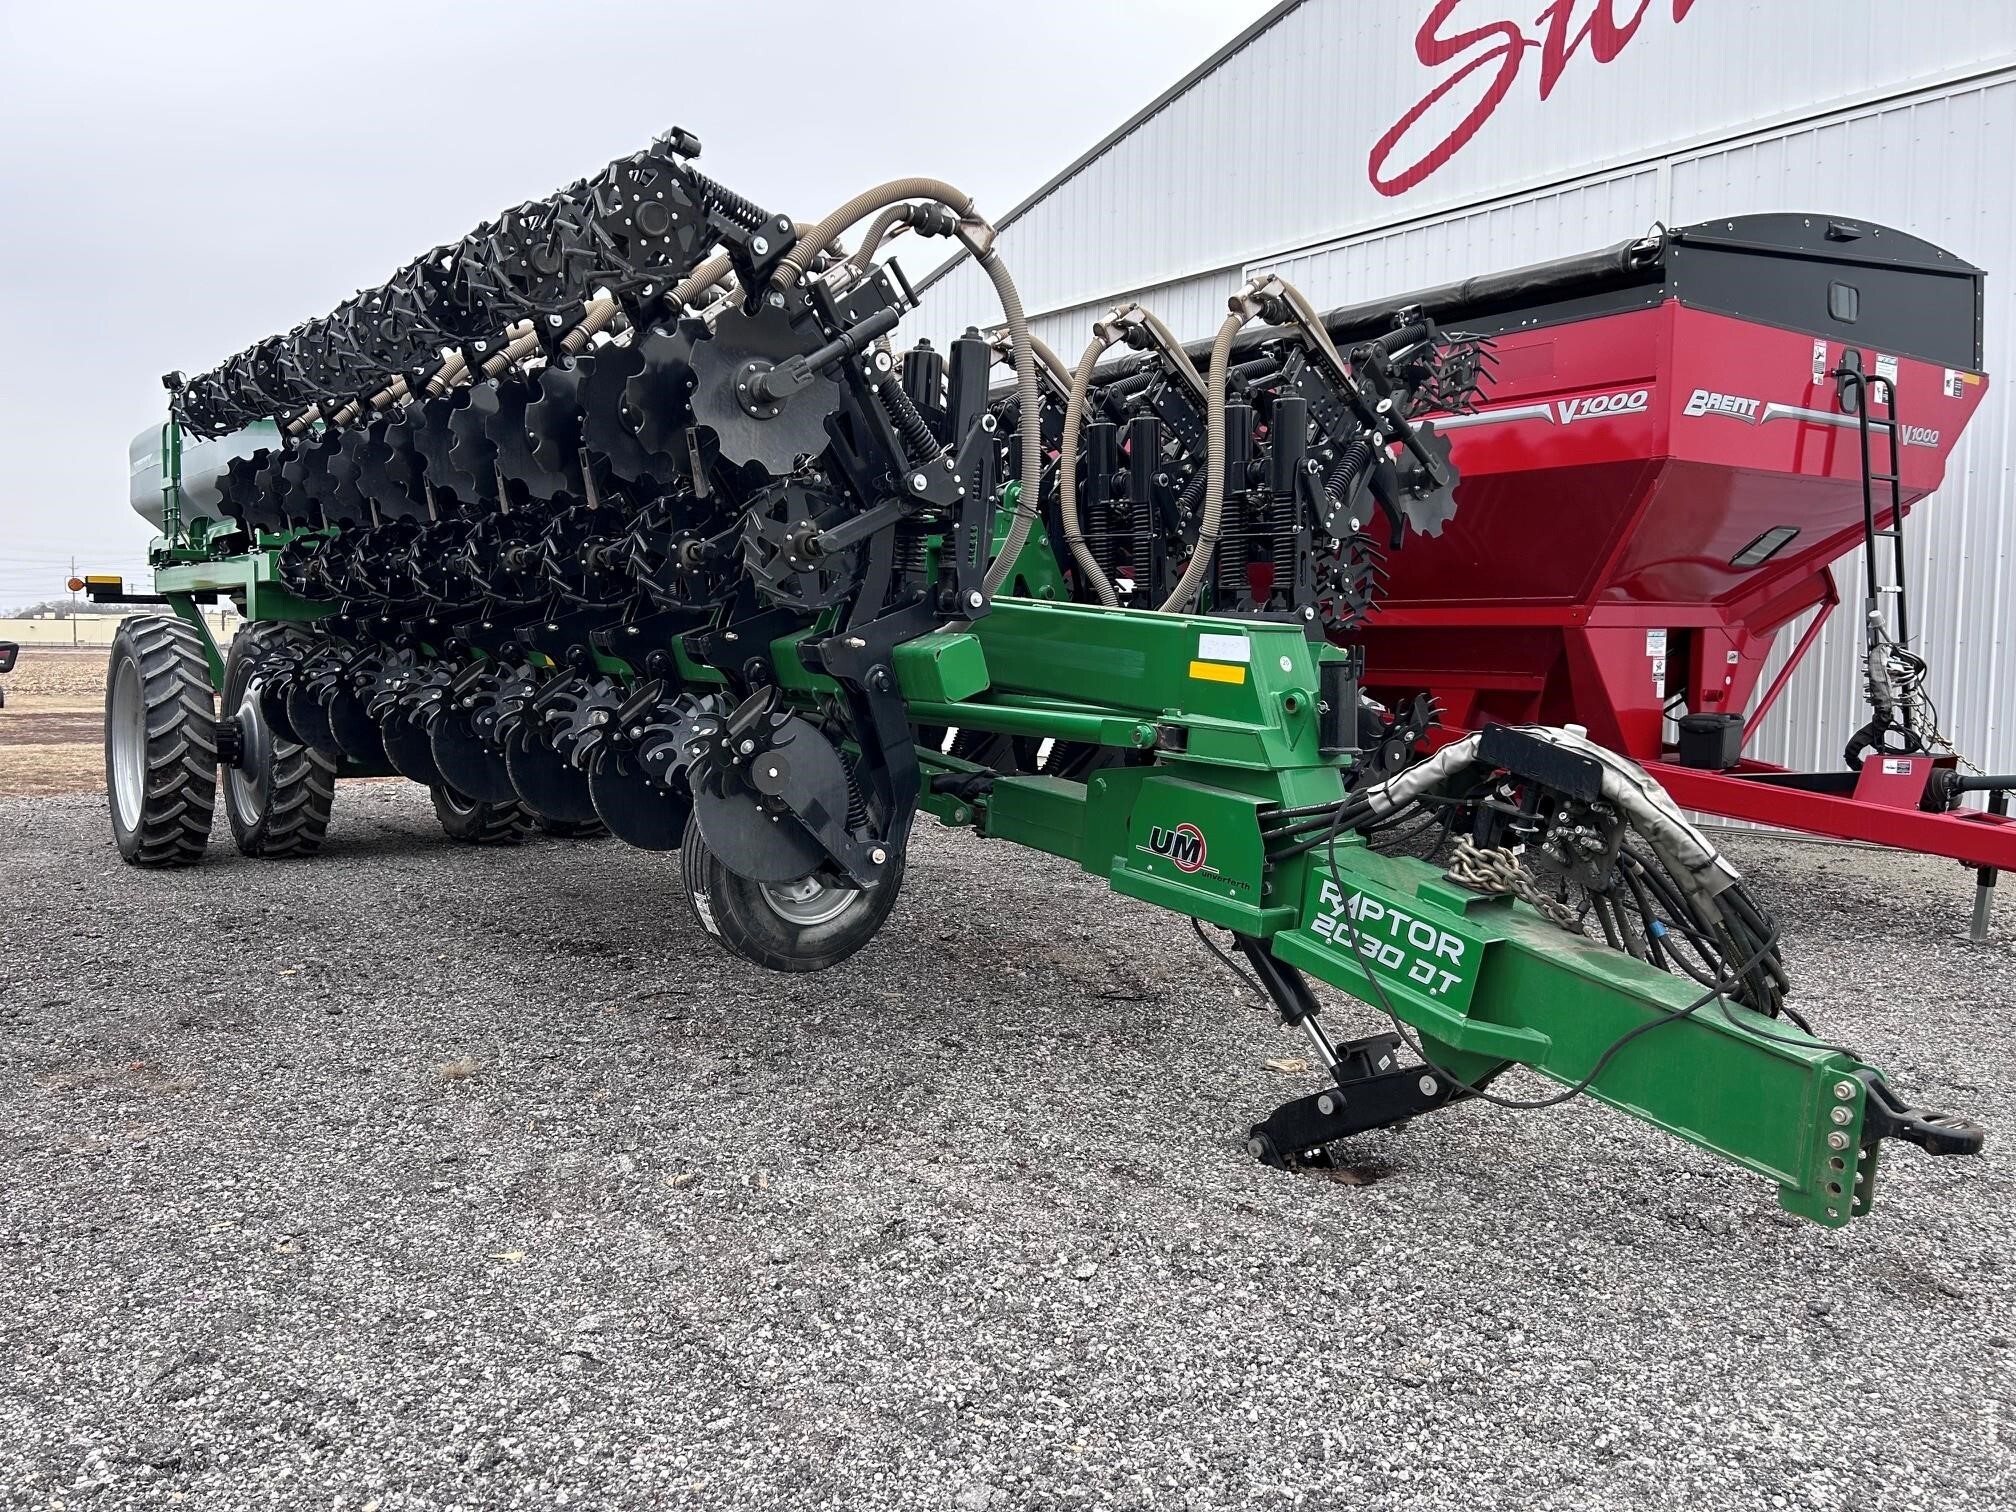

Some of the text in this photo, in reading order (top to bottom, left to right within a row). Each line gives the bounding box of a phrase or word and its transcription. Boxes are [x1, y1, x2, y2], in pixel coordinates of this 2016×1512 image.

[1557, 390, 1649, 425] V1000
[1682, 389, 1760, 417] BRENT
[1901, 425, 1939, 446] V1000
[1149, 825, 1201, 865] UM
[1201, 870, 1251, 891] unverferth
[1319, 879, 1465, 967] RAPTOR
[1310, 912, 1463, 995] 2030 DT
